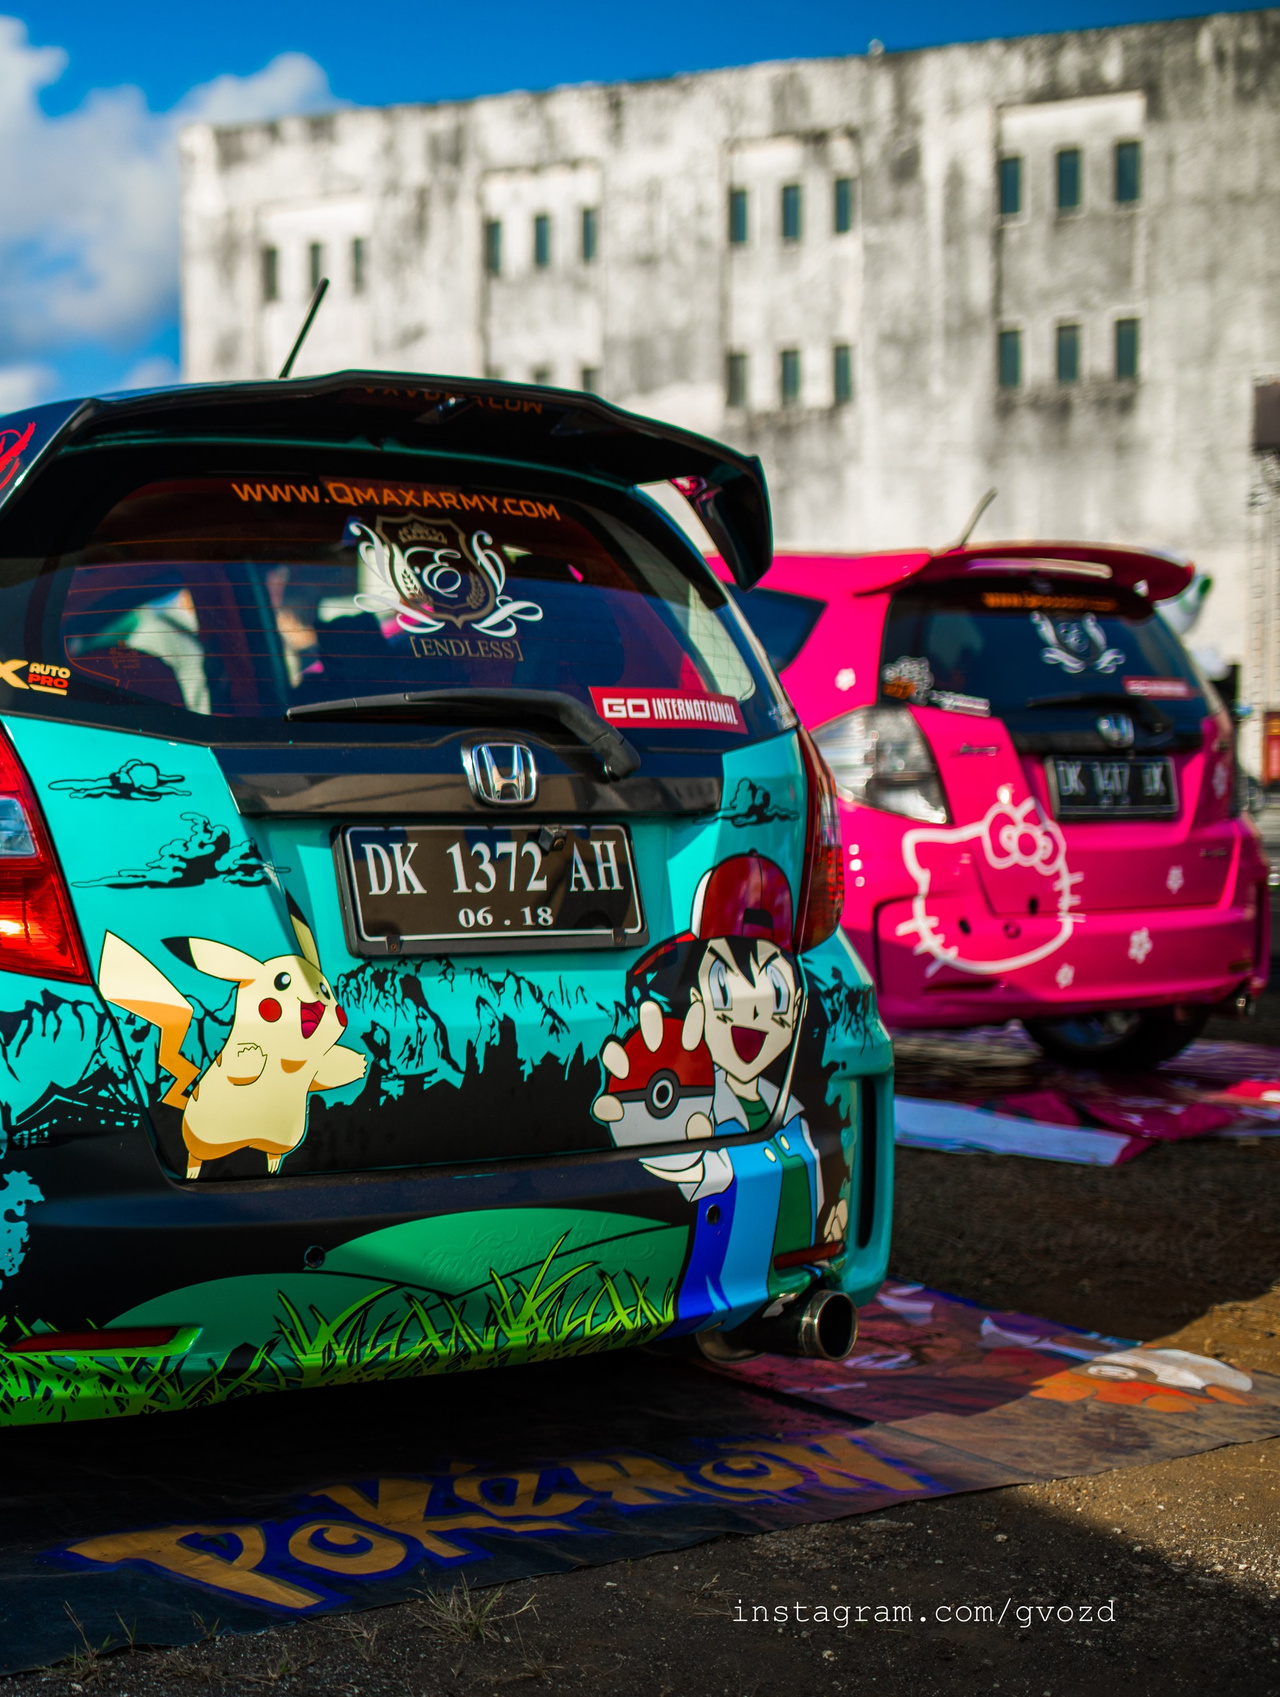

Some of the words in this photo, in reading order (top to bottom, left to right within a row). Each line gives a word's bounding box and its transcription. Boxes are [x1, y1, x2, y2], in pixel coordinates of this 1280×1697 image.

[231, 482, 561, 521] WWW.QMAXARMY.COM
[28, 673, 69, 689] PRO
[29, 662, 70, 679] AUTO
[651, 697, 738, 725] INTERNATIONAL
[361, 842, 427, 895] DK
[446, 841, 548, 893] 1372
[570, 840, 624, 892] AH
